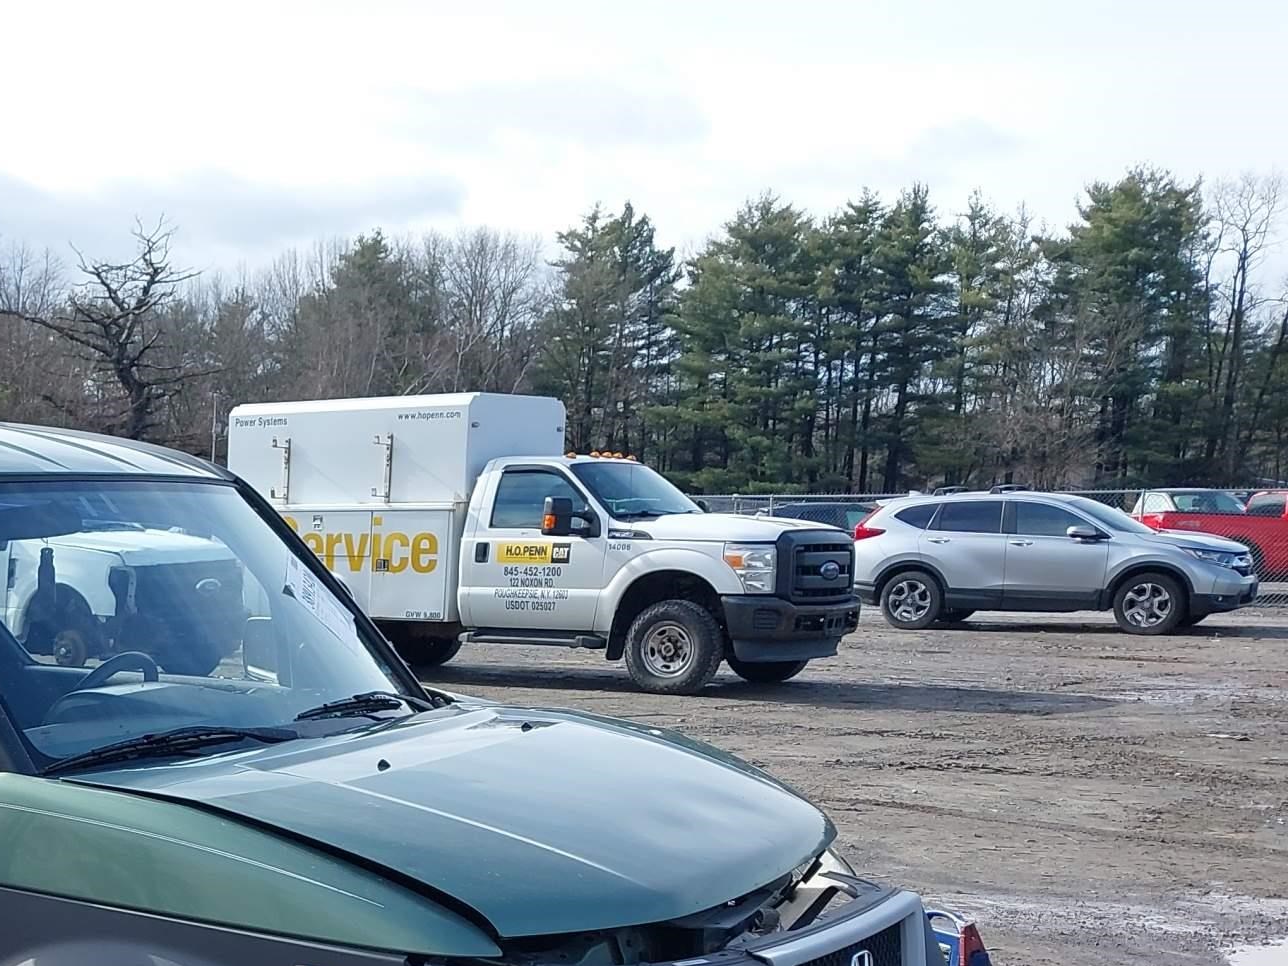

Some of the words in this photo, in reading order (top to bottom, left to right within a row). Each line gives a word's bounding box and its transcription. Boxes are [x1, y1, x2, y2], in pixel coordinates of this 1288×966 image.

[398, 410, 462, 421] www.hopenn.com
[235, 417, 257, 428] Power
[258, 416, 288, 427] Systems
[505, 545, 548, 557] H.O.PENN
[552, 547, 570, 559] CAT
[503, 566, 562, 577] 845-452-1200
[509, 577, 520, 588] 122
[520, 577, 543, 588] NOXON
[505, 599, 530, 610] USDOT
[531, 601, 556, 611] 025027
